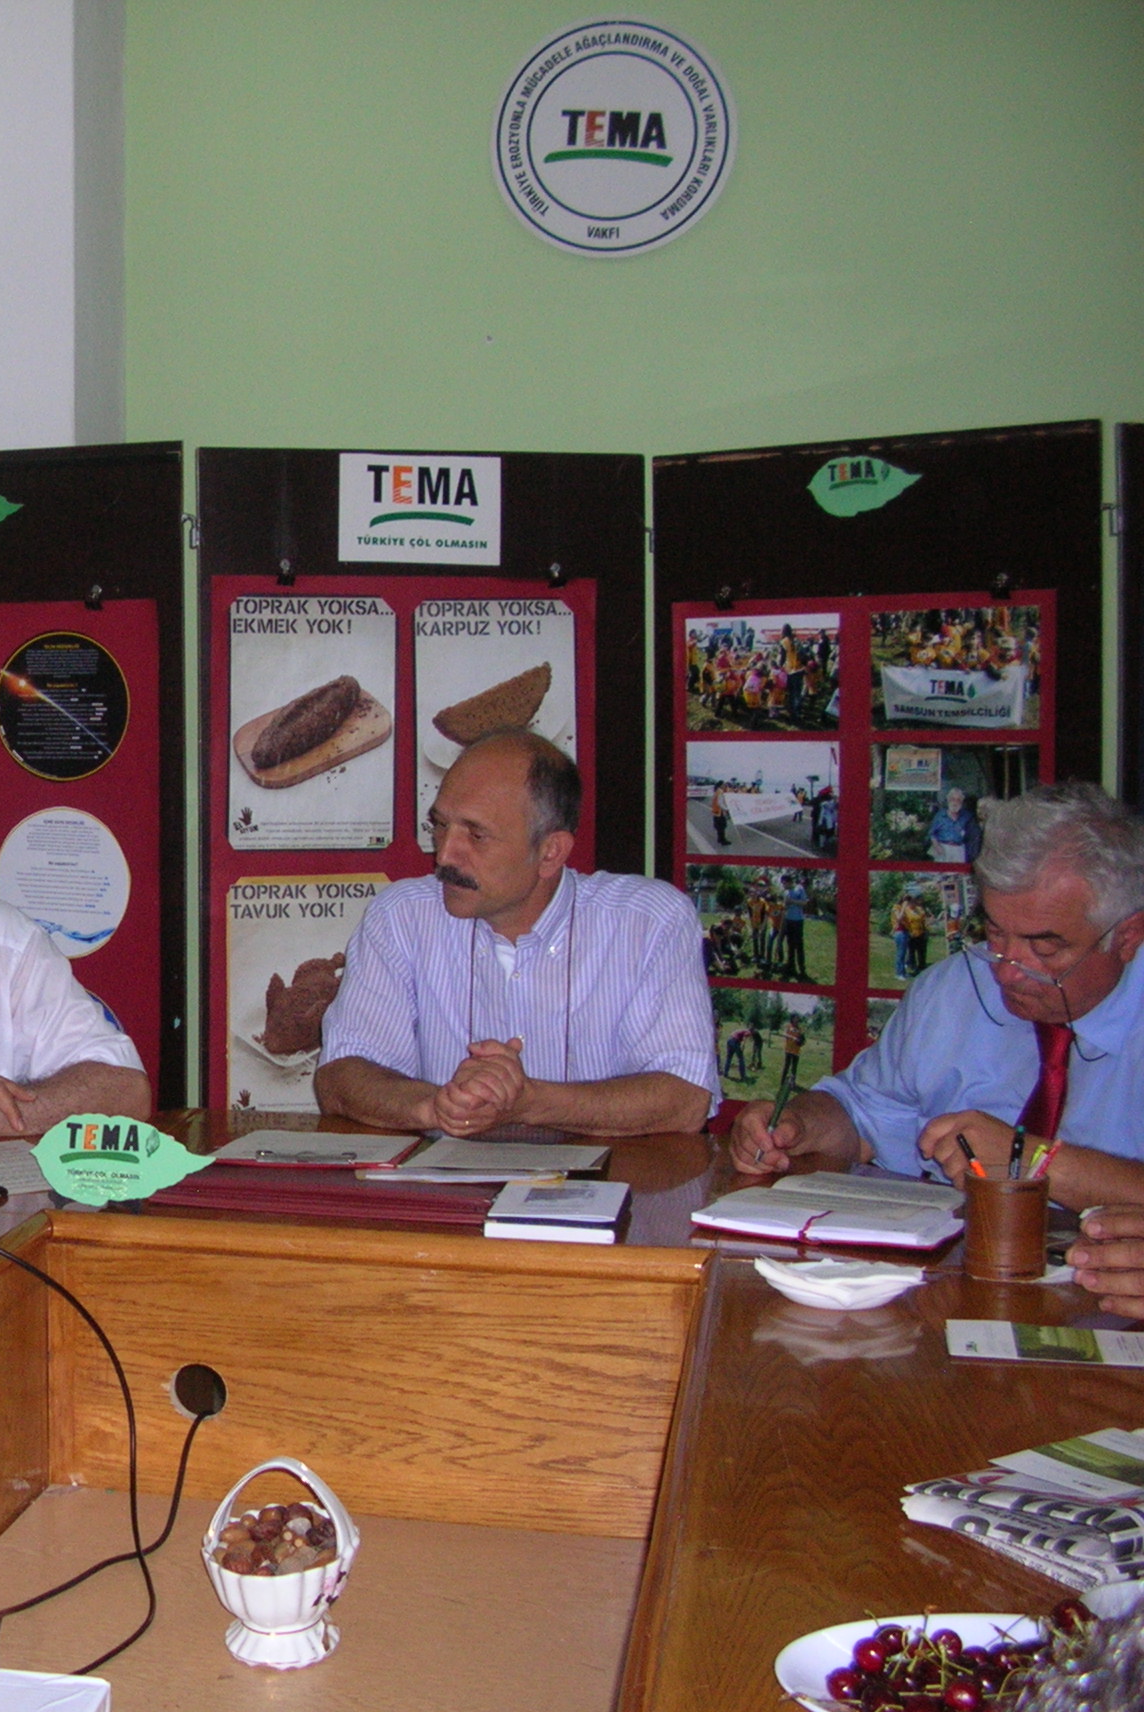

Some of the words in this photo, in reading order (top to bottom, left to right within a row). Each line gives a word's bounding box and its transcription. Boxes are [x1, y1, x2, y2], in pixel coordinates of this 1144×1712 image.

[575, 32, 670, 57] AĞAÇLANDIRMA
[670, 52, 686, 70] VE
[523, 46, 573, 98] MÜCADELE
[683, 64, 711, 101] DOĞAL
[508, 100, 526, 170] EROZYONLA
[561, 110, 667, 149] TEMA
[698, 104, 718, 176] VARLIKLARI
[515, 171, 549, 217] TÜRKİYE
[660, 177, 704, 221] KORUMA
[587, 226, 620, 239] VAKFI
[828, 460, 875, 481] TEMA
[367, 465, 478, 506] TEMA
[357, 534, 405, 546] TÜRKİYE
[409, 536, 431, 549] ÇÖL
[436, 539, 488, 549] OLMASIN
[235, 599, 308, 615] TOPRAK
[317, 600, 394, 615] YOKSA...
[418, 602, 490, 617] TOPRAK
[498, 601, 571, 616] YOKSA...
[232, 618, 298, 634] EKMEK
[416, 621, 490, 636] KARPUZ
[930, 679, 964, 695] TEMA
[894, 704, 935, 717] SAMSUN
[231, 885, 306, 899] TOPRAK
[231, 903, 290, 919] TAVUK
[67, 1122, 139, 1151] TEMA
